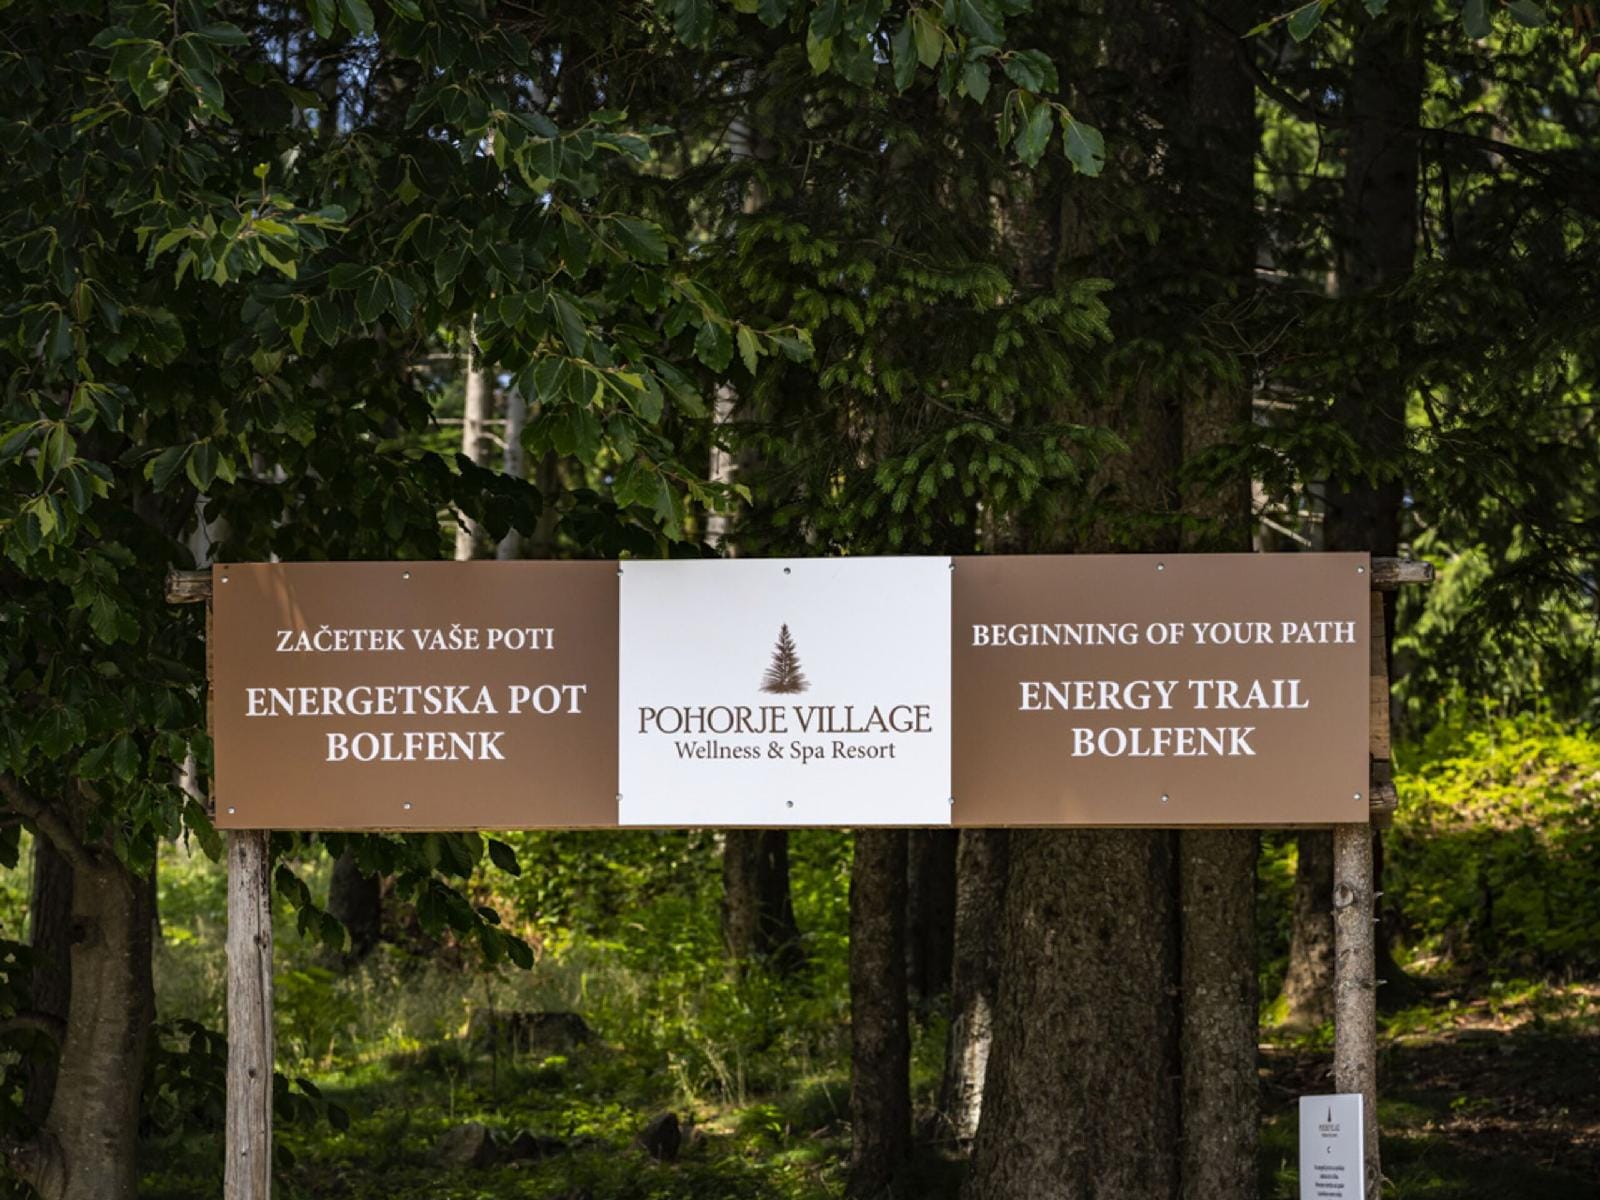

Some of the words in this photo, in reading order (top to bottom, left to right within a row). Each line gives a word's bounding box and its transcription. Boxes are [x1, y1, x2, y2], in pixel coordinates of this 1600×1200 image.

[276, 625, 405, 652] ZAČETEK
[411, 623, 480, 650] VAŠE
[487, 628, 554, 650] POTI
[972, 622, 1139, 646] BEGINNING
[1145, 622, 1185, 645] OF
[1191, 622, 1274, 644] YOUR
[1280, 621, 1356, 644] PATH
[245, 685, 499, 717] ENERGETSKA
[508, 684, 587, 714] POT
[1018, 680, 1179, 711] ENERGY
[1188, 679, 1310, 710] TRAIL
[638, 705, 789, 735] POHORJE
[792, 704, 933, 734] VILLAGE
[325, 731, 505, 762] BOLFENK
[674, 739, 762, 760] Wellness
[767, 740, 784, 760] &
[789, 740, 825, 765] Spa
[831, 740, 896, 759] Resort
[1071, 726, 1257, 757] BOLFENK
